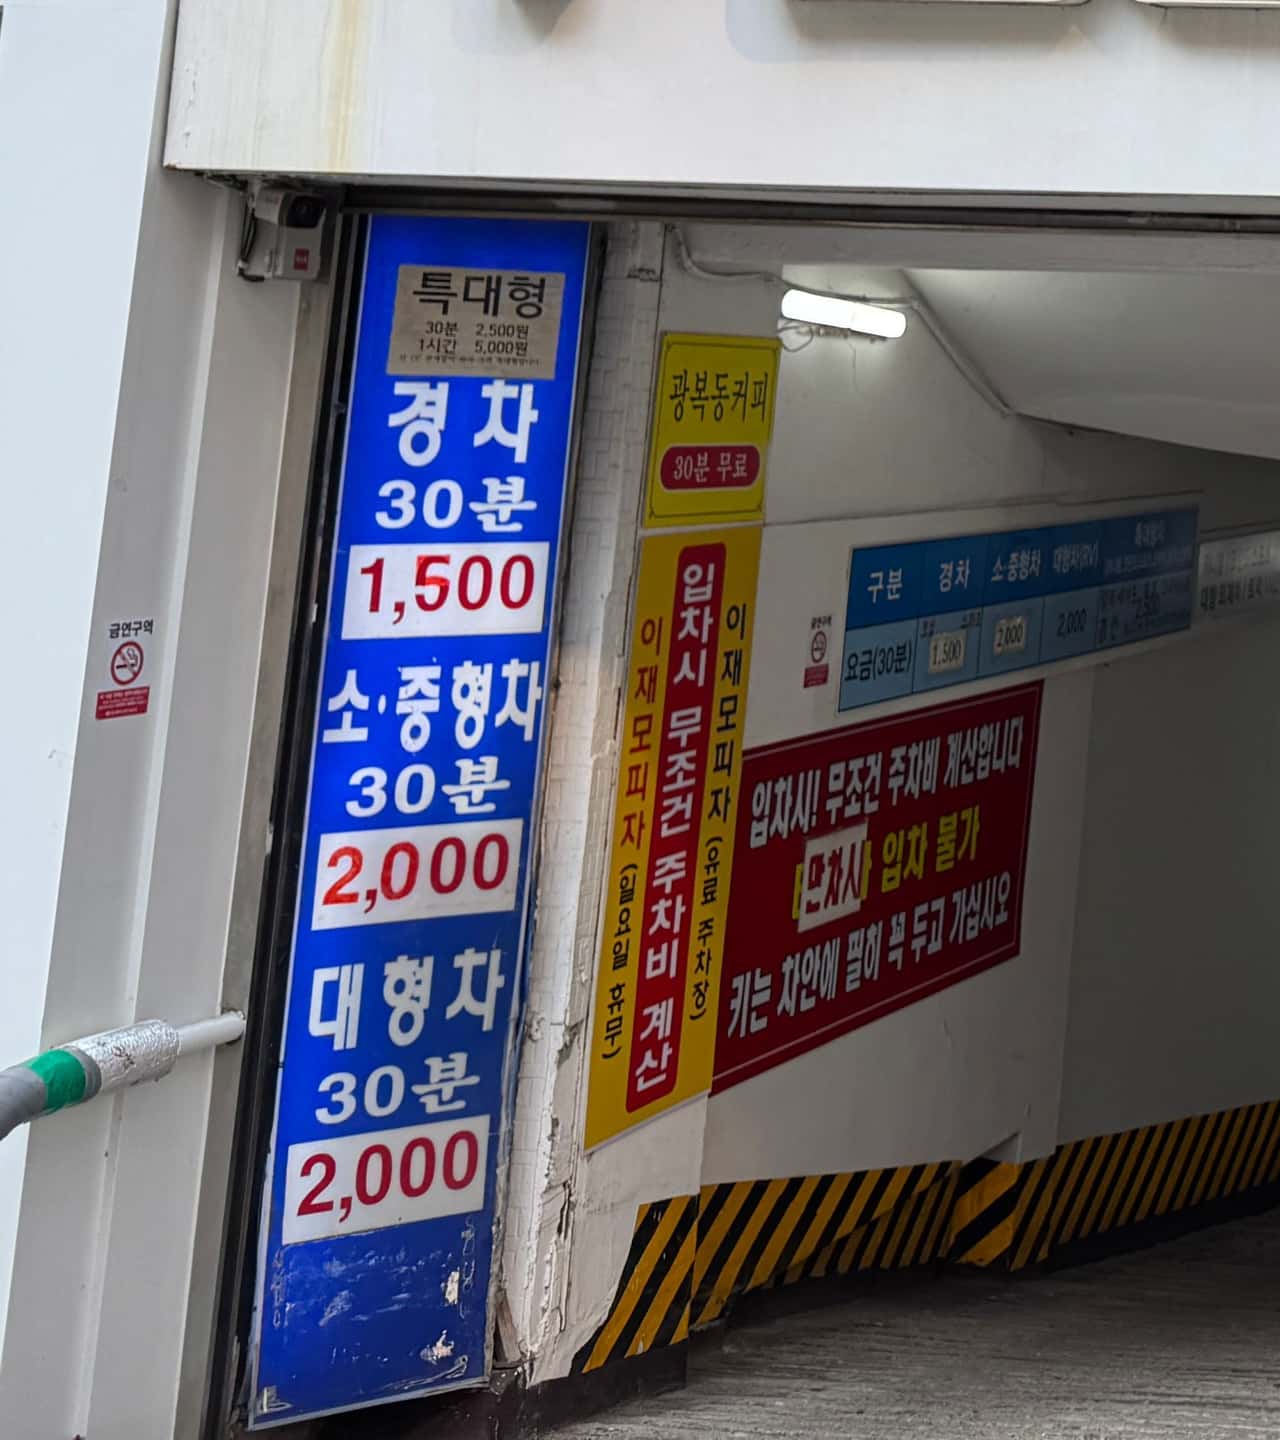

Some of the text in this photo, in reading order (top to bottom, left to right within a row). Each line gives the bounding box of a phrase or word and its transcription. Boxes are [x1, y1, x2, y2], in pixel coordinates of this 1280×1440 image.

[413, 272, 546, 320] 특대형
[669, 368, 769, 423] 광복동커피
[375, 477, 538, 533] 30분
[673, 452, 748, 482] 30분 무료
[360, 553, 536, 625] 1,500
[867, 568, 904, 604] 구분
[938, 558, 971, 593] 경차
[843, 638, 914, 682] 요금(30분)
[620, 615, 664, 850] 이재모피자
[708, 603, 748, 825] 이재모피자
[347, 756, 512, 817] 30분
[826, 751, 883, 825] 무조건
[888, 735, 941, 807] 주차비
[944, 715, 1025, 789] 계산합니다
[635, 563, 716, 1093] 입차시 무조건 주차비 계산
[881, 821, 928, 893] 입차
[936, 805, 980, 873] 불가
[321, 831, 511, 914] 2,000
[727, 870, 1012, 1038] 키는 차안에 필히 꼭 두고 가십시오
[308, 947, 506, 1051] 대형차
[314, 1051, 481, 1125] 30분
[296, 1129, 480, 1224] 2,000
